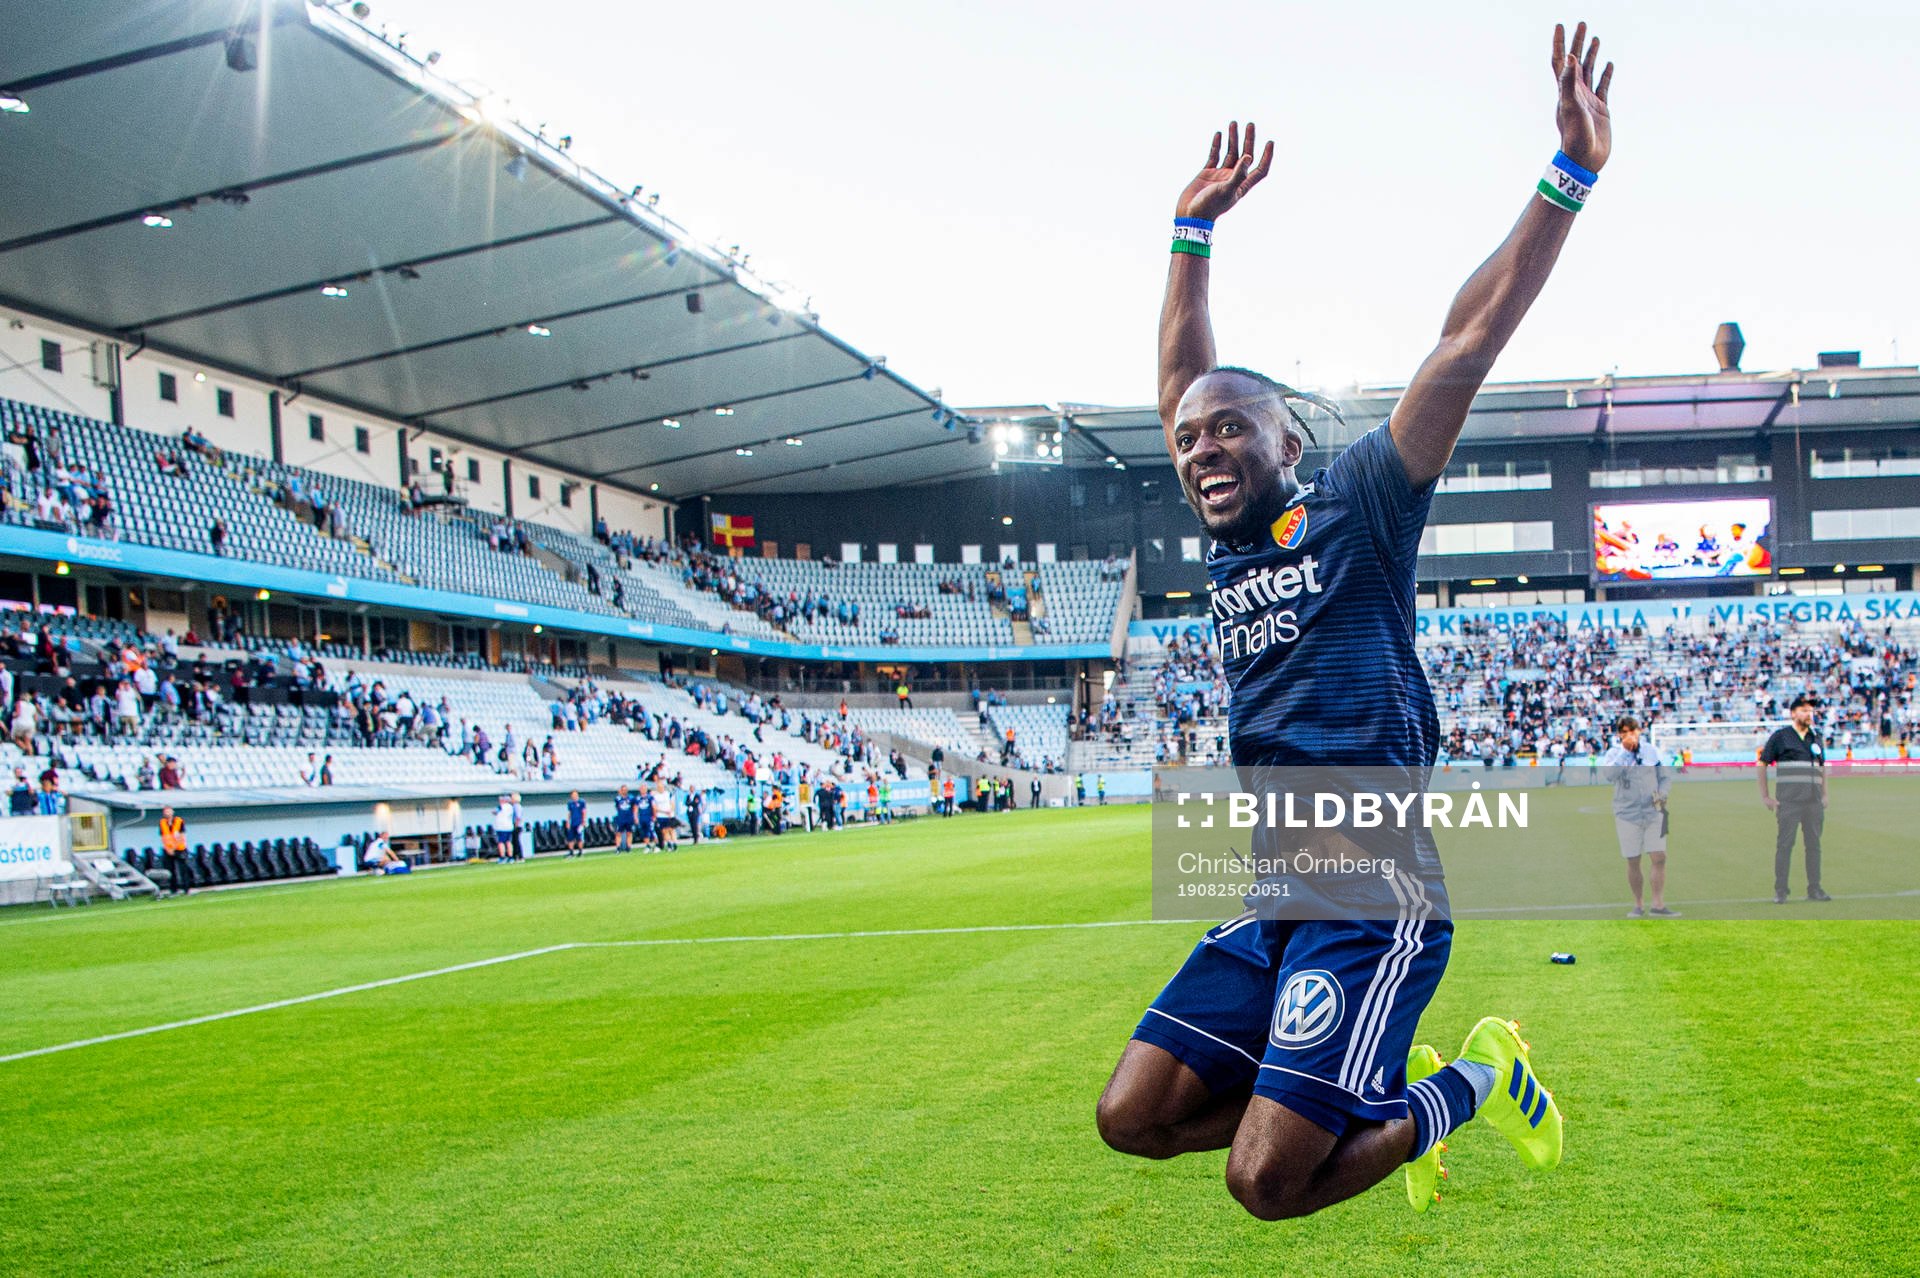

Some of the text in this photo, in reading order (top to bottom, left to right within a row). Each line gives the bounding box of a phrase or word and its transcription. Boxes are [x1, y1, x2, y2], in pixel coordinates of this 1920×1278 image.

[1578, 608, 1648, 631] ALLA
[1716, 598, 1920, 624] VI SEGRA SKA
[1219, 610, 1299, 663] Finans
